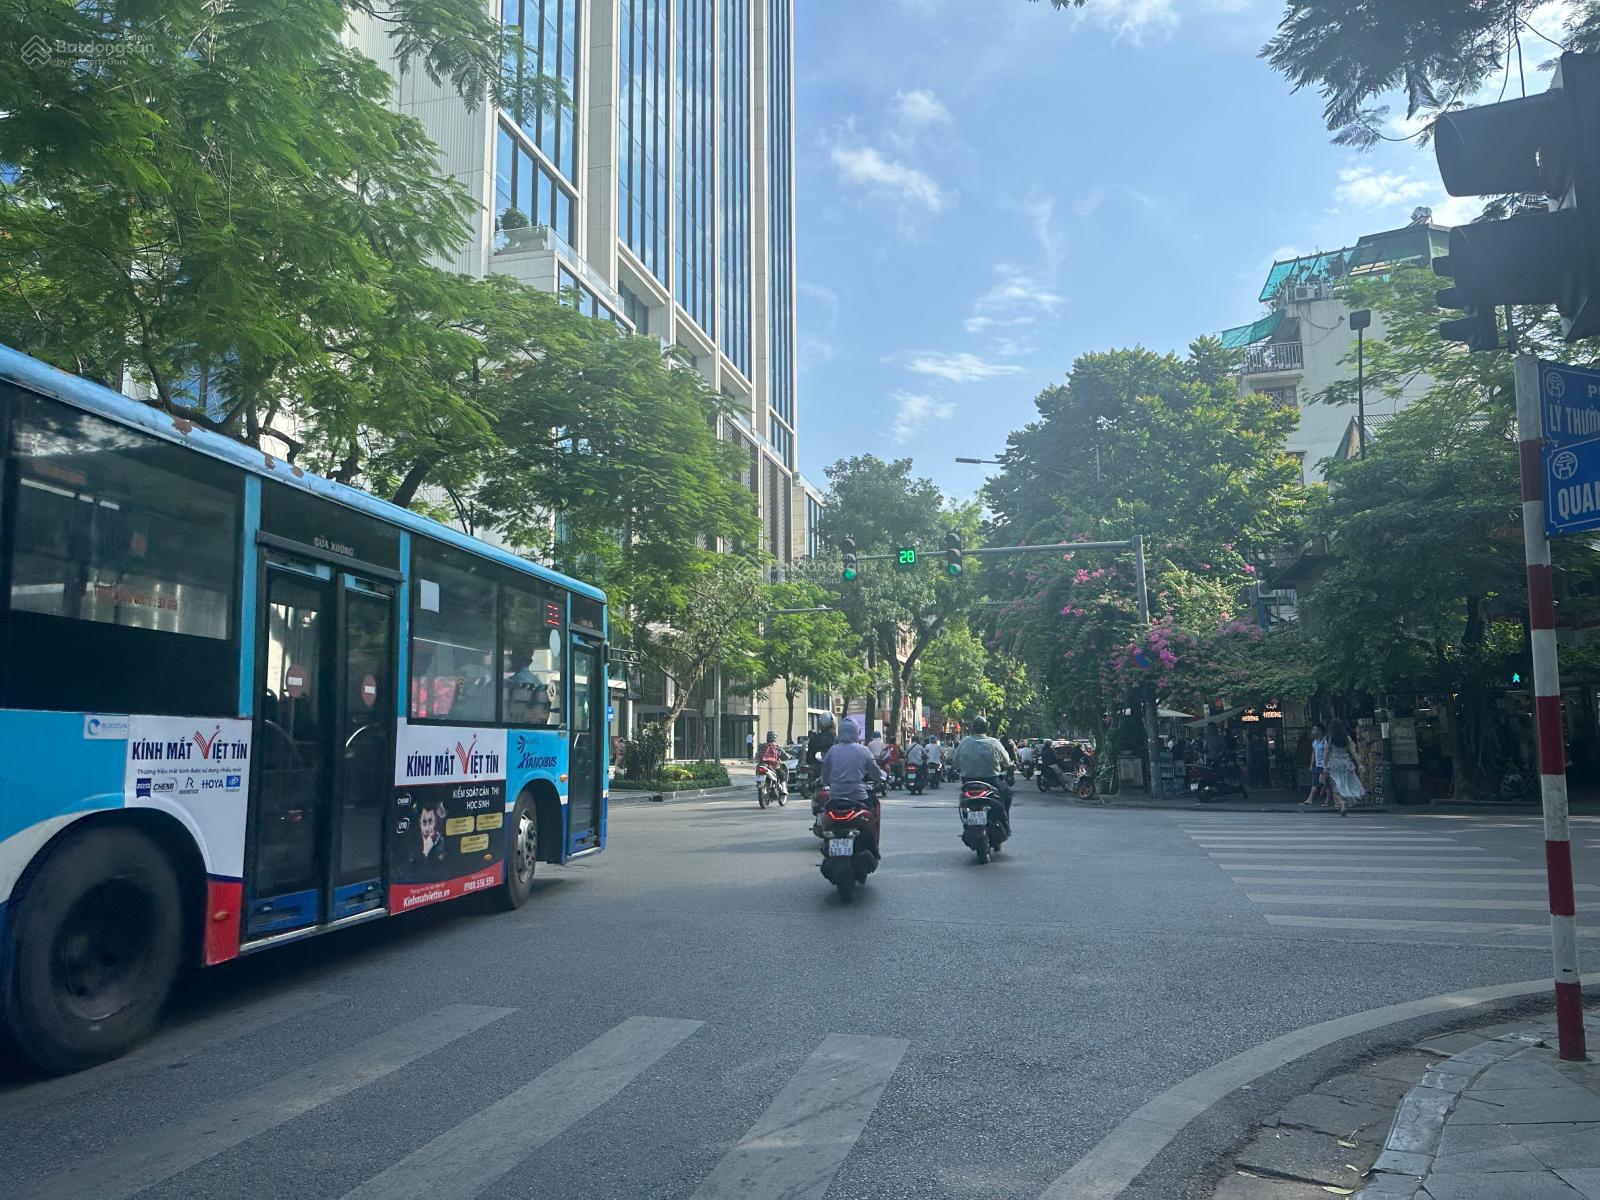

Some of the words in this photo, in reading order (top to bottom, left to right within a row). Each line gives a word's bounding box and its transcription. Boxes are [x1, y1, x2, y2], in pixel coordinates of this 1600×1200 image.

[1588, 384, 1600, 398] P
[1550, 400, 1561, 433] LÝ
[1565, 404, 1600, 436] THƯỜ
[900, 550, 915, 564] 28
[132, 738, 163, 760] KÍNH
[166, 736, 193, 760] MẮT
[231, 739, 248, 760] TÍN
[407, 750, 432, 777] KÍNH
[434, 747, 455, 776] MẮT
[486, 750, 499, 774] TÍN
[201, 779, 224, 789] HOYA
